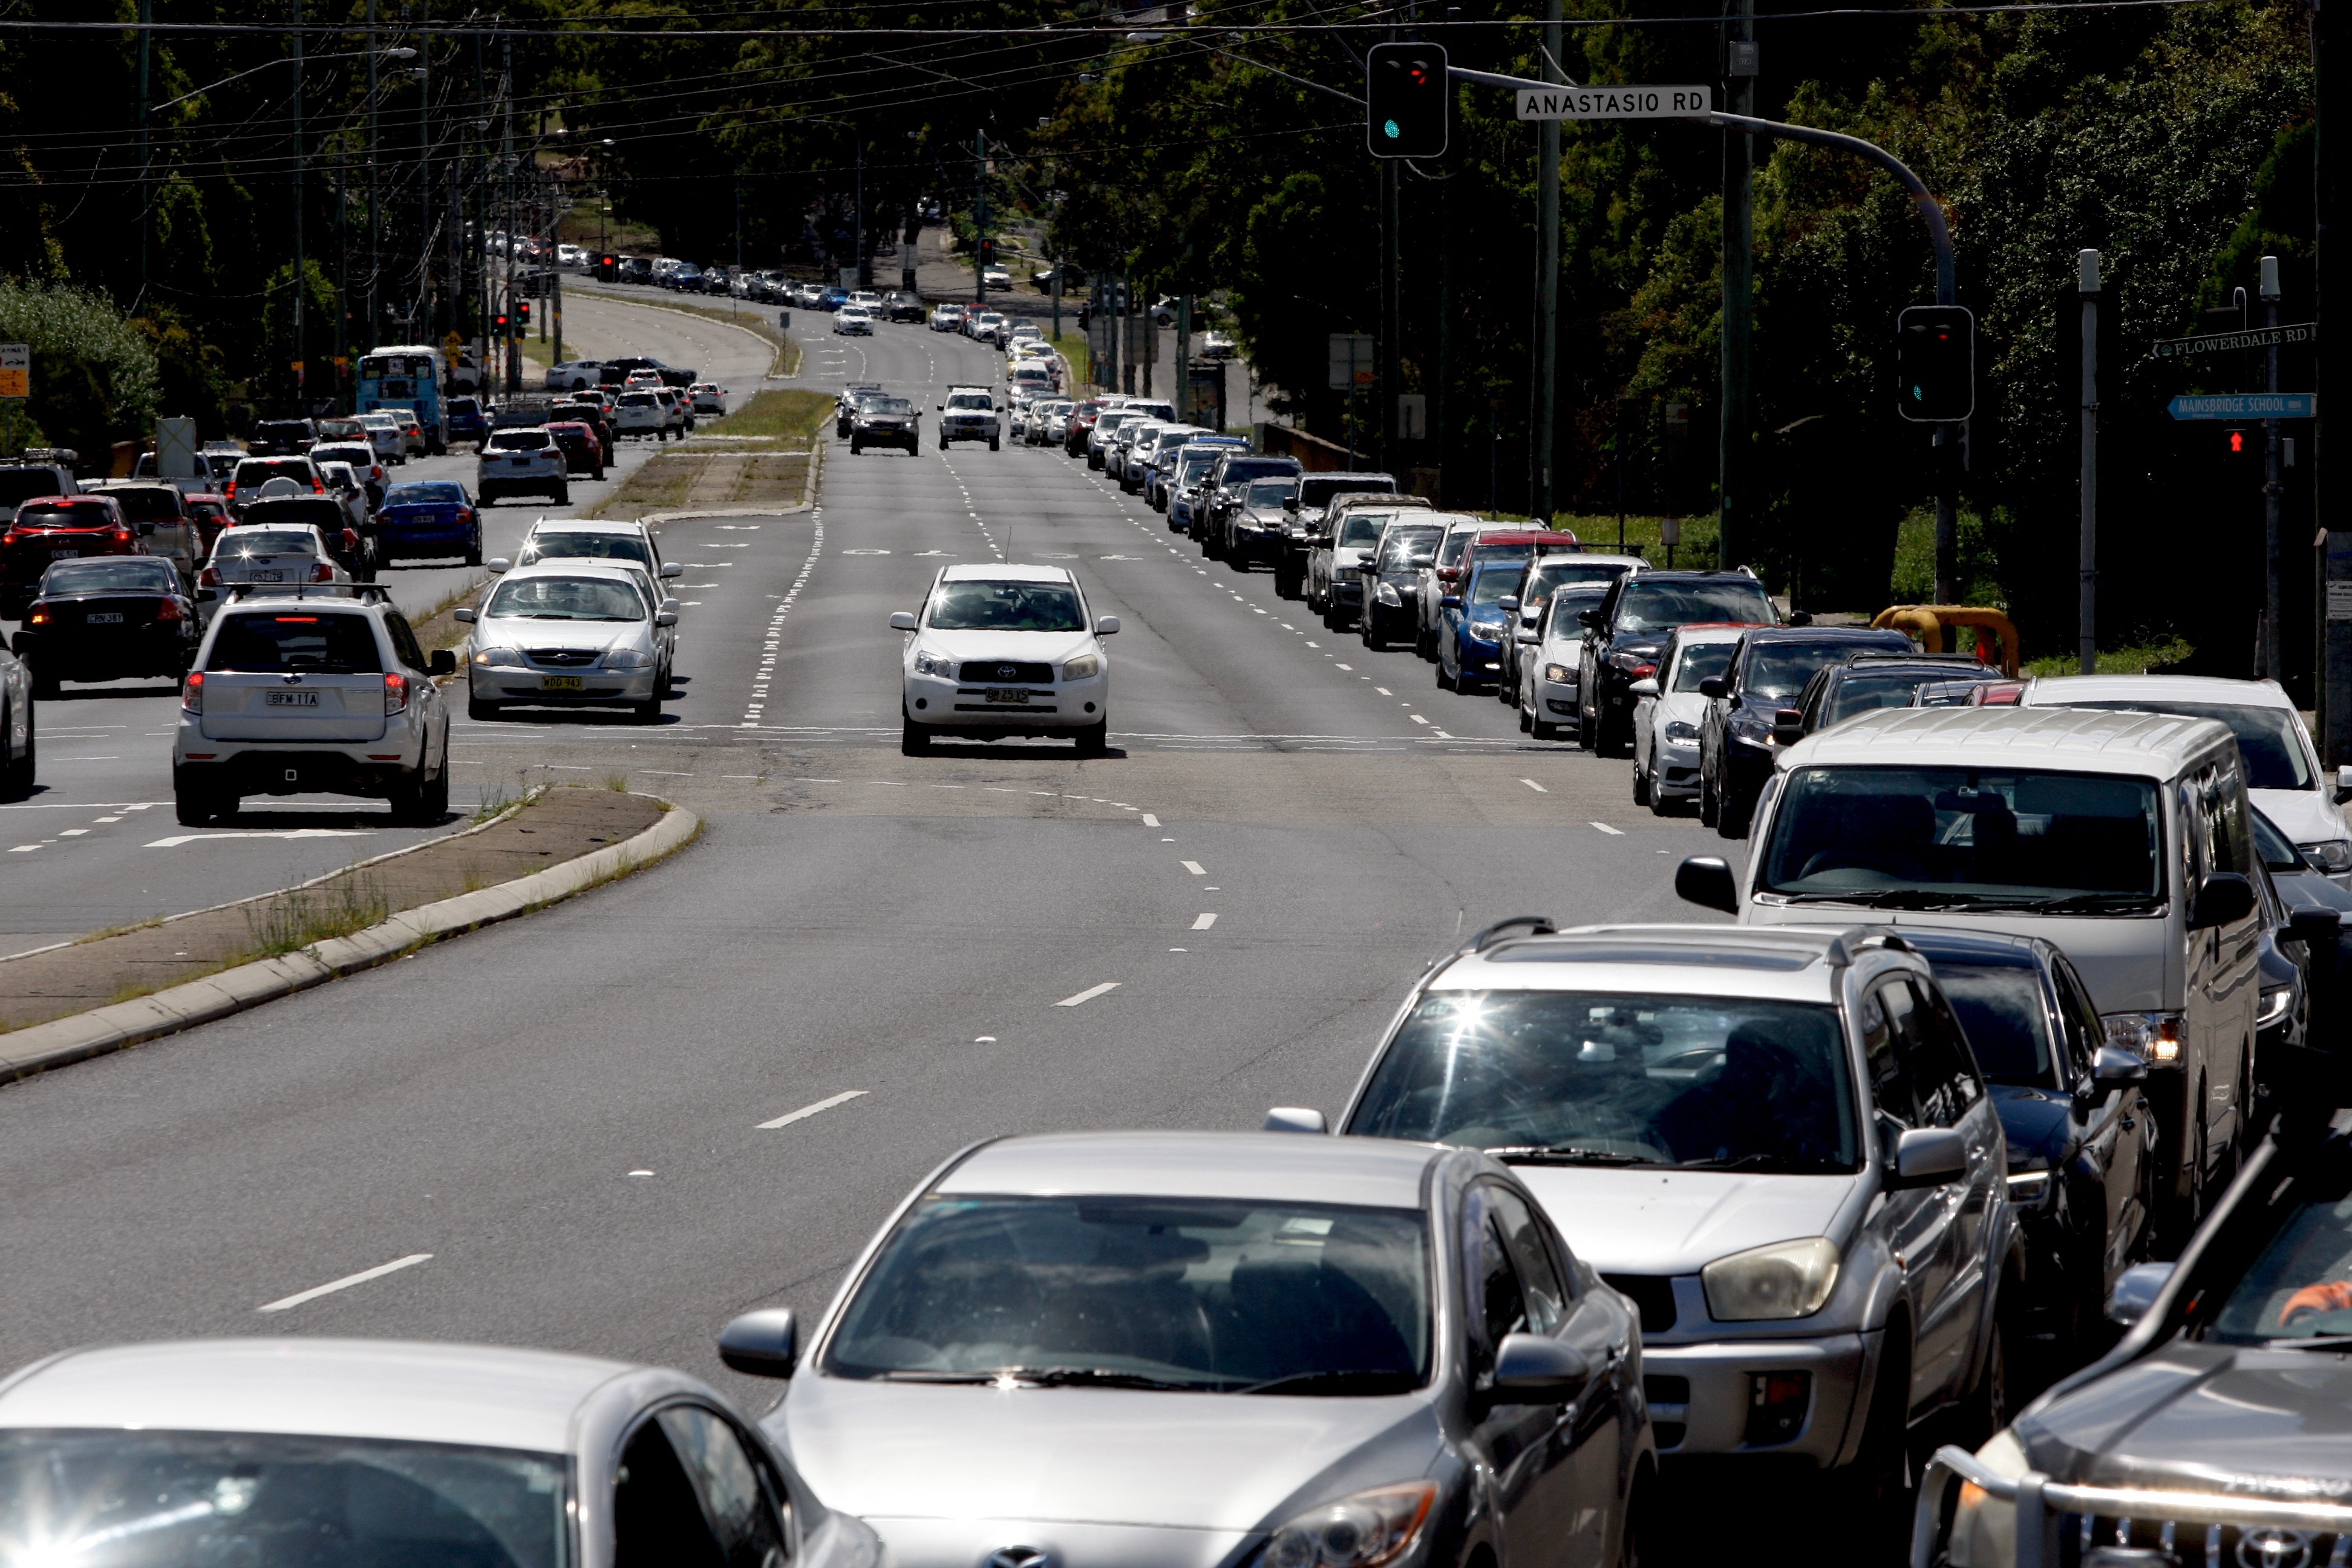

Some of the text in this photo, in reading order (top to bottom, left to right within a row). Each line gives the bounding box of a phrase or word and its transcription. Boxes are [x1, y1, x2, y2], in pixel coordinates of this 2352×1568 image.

[1526, 93, 1703, 114] ANASTASIO RD
[2175, 332, 2281, 356] FLOWERDALE
[2286, 328, 2307, 342] RD
[2178, 398, 2244, 413] MAINSBRIDGE
[2249, 397, 2284, 411] SCHOOL
